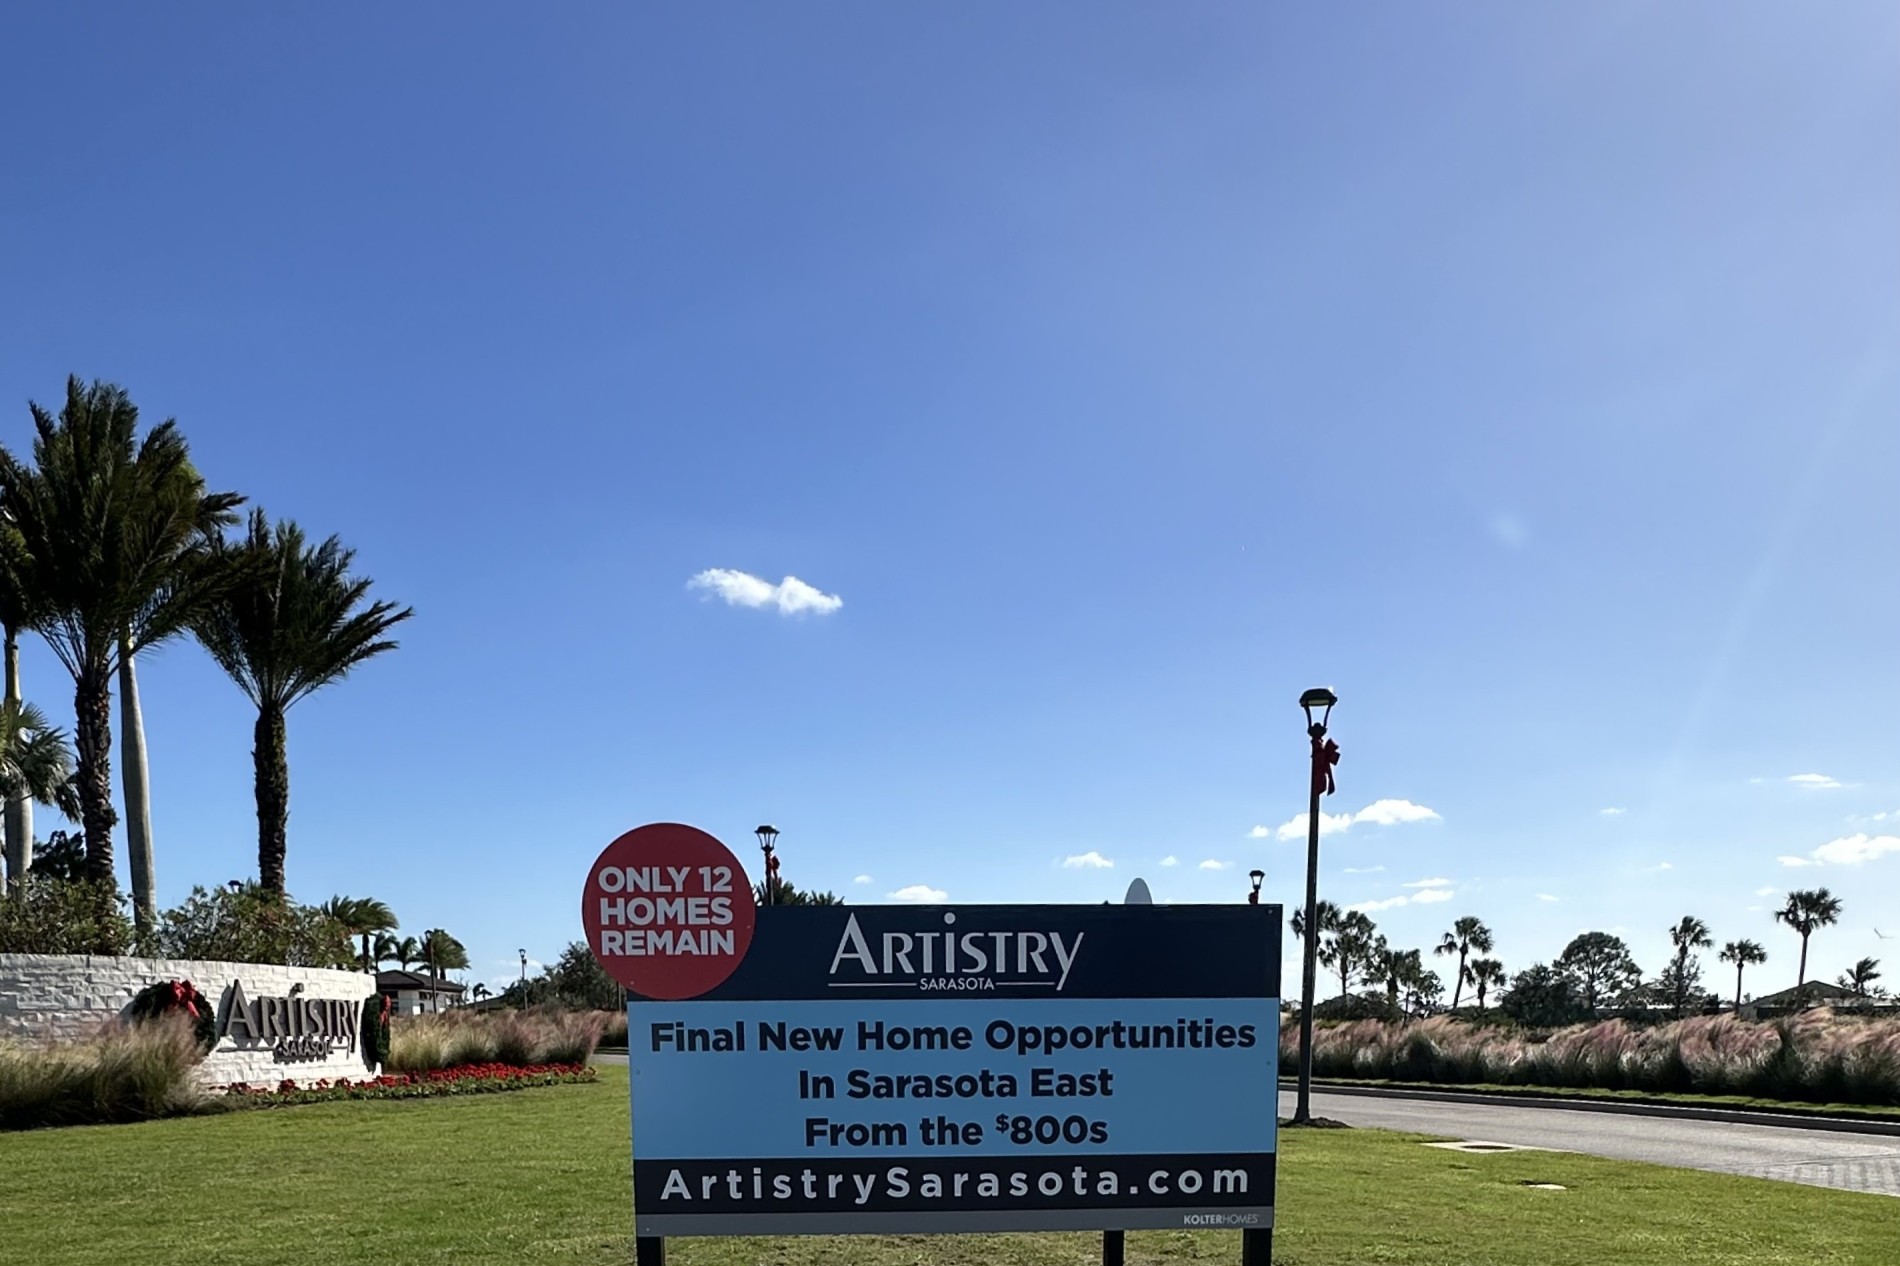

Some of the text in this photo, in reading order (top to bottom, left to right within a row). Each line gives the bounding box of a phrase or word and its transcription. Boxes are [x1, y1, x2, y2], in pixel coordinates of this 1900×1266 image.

[598, 866, 733, 893] ONLY 12
[600, 897, 733, 926] HOMES
[601, 930, 735, 956] REMAIN
[919, 977, 995, 991] SARASOTA
[651, 1018, 1256, 1055] Final New Home Opportunities
[799, 1067, 1114, 1099] In Sarasota East
[805, 1113, 1109, 1147] From the $800s
[660, 1166, 1249, 1205] ArtistrySarasota.com
